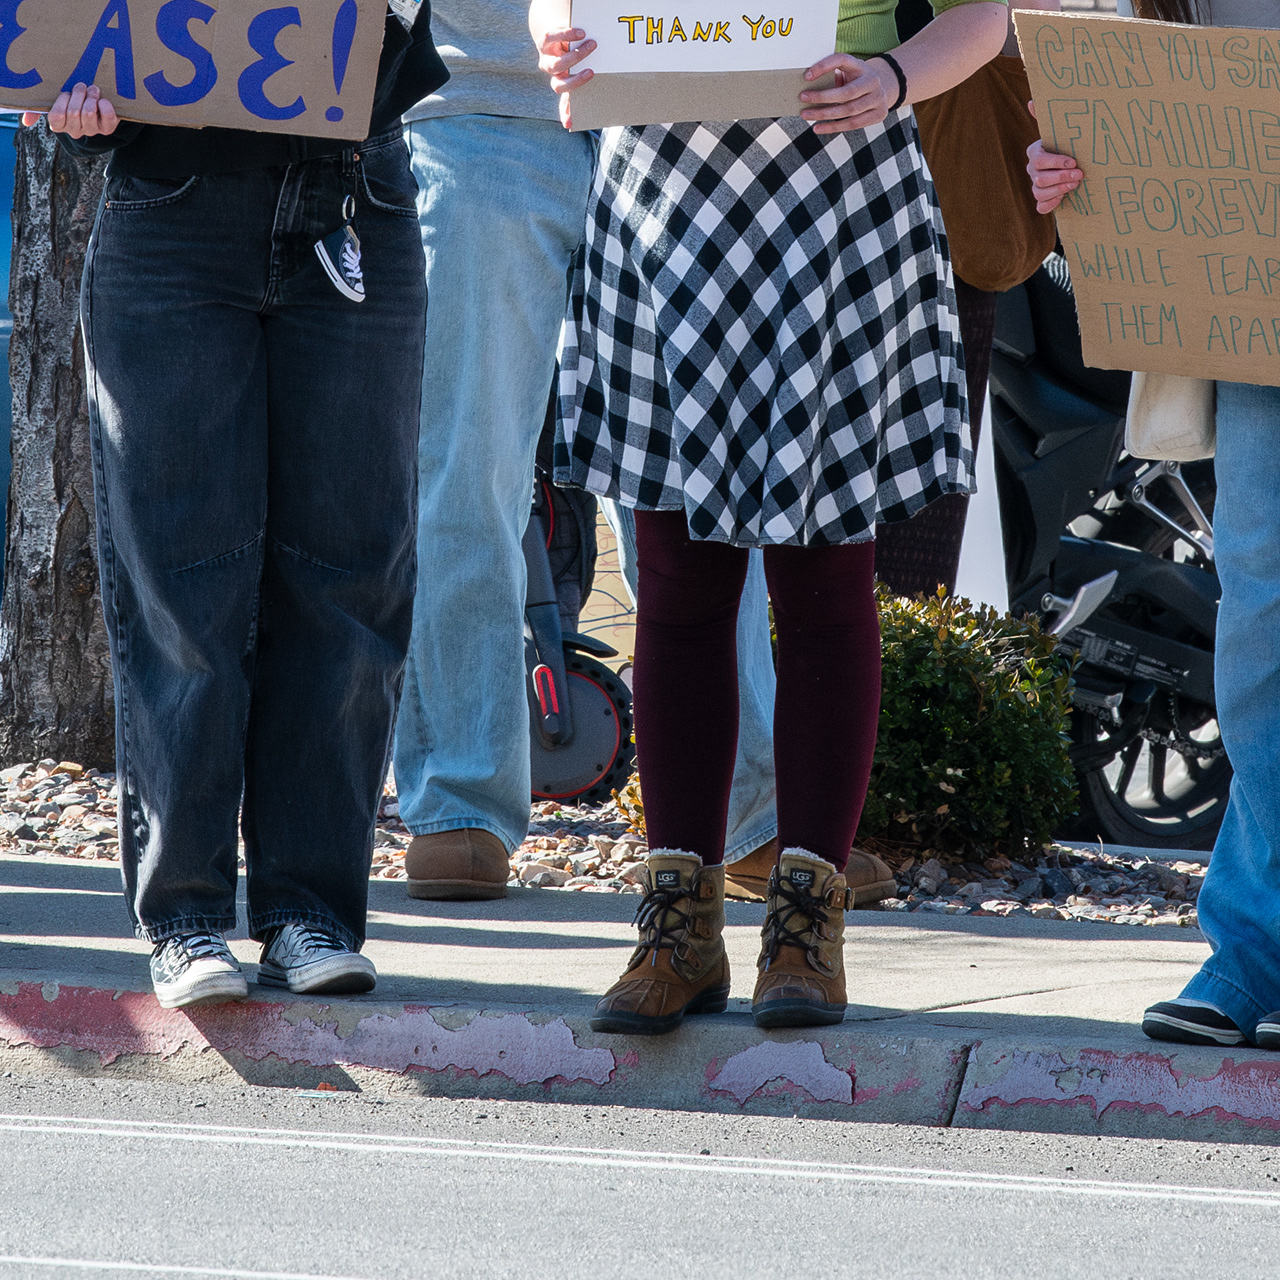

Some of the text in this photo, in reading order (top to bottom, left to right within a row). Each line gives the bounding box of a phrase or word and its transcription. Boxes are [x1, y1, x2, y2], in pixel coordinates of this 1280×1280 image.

[618, 14, 794, 45] THANK YOU
[1035, 25, 1153, 89] CAN
[1158, 33, 1216, 91] YOU
[1074, 242, 1177, 287] WHILE
[1100, 302, 1182, 348] THEM
[658, 873, 677, 882] UGG
